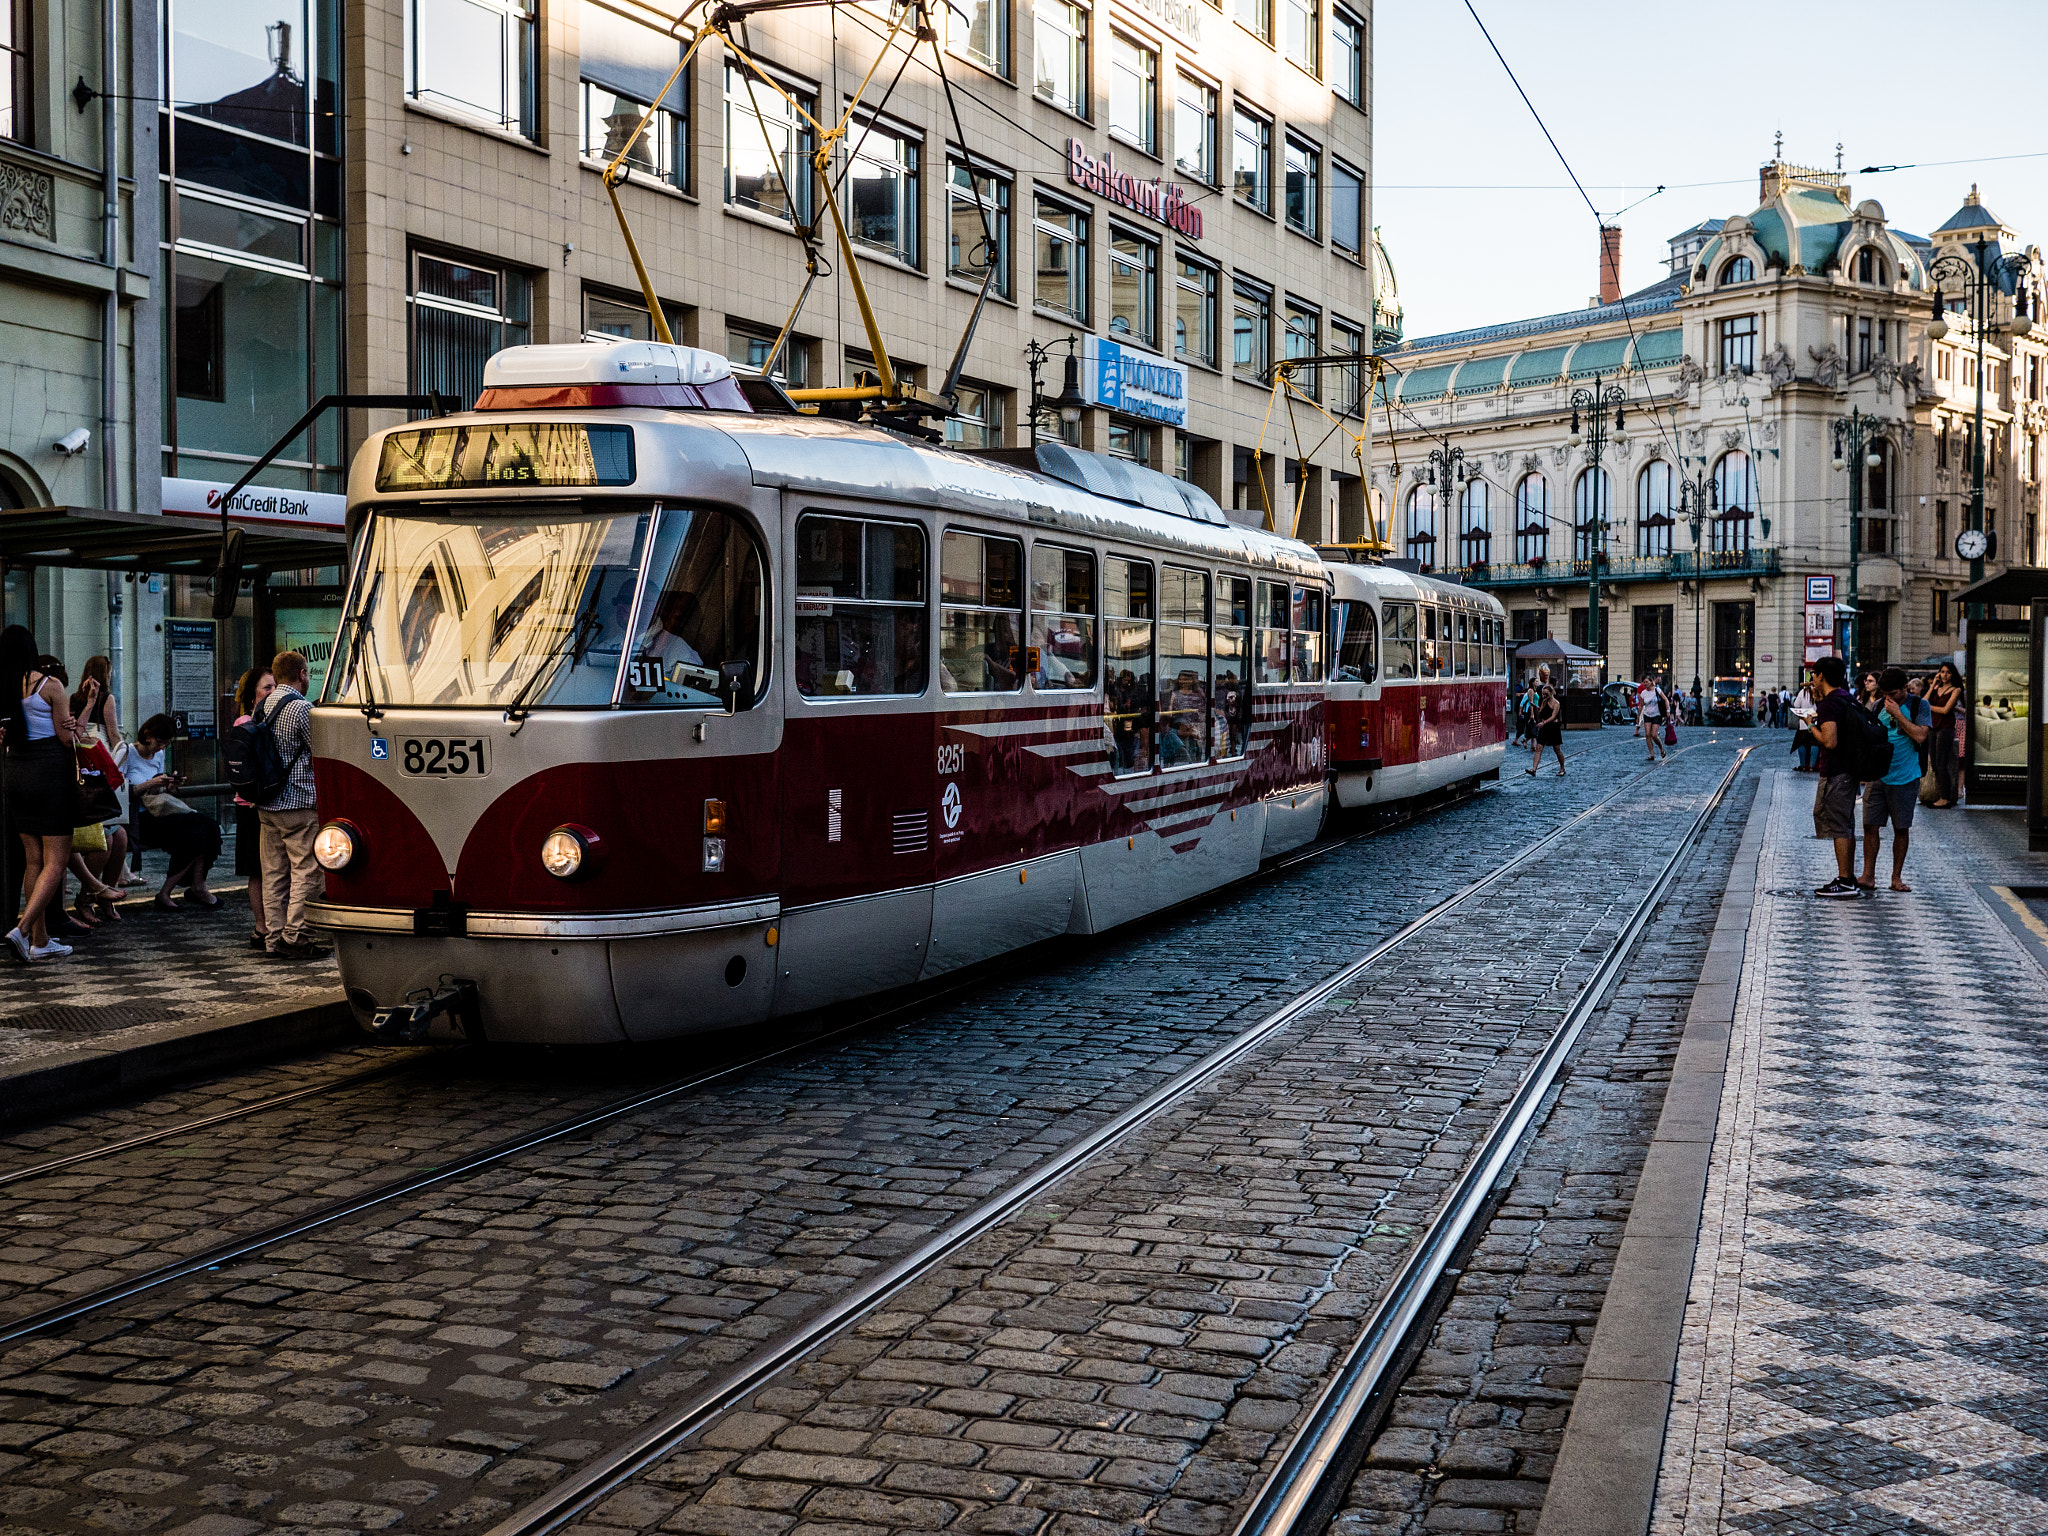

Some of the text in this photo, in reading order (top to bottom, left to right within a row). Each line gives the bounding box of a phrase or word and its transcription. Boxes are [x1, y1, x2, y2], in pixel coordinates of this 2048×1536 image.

[1068, 137, 1203, 239] Bankovní dům
[1120, 354, 1183, 400] PIONEER
[280, 497, 309, 516] Bank
[629, 661, 663, 687] 511
[404, 739, 485, 775] 8251
[937, 743, 965, 775] 8251
